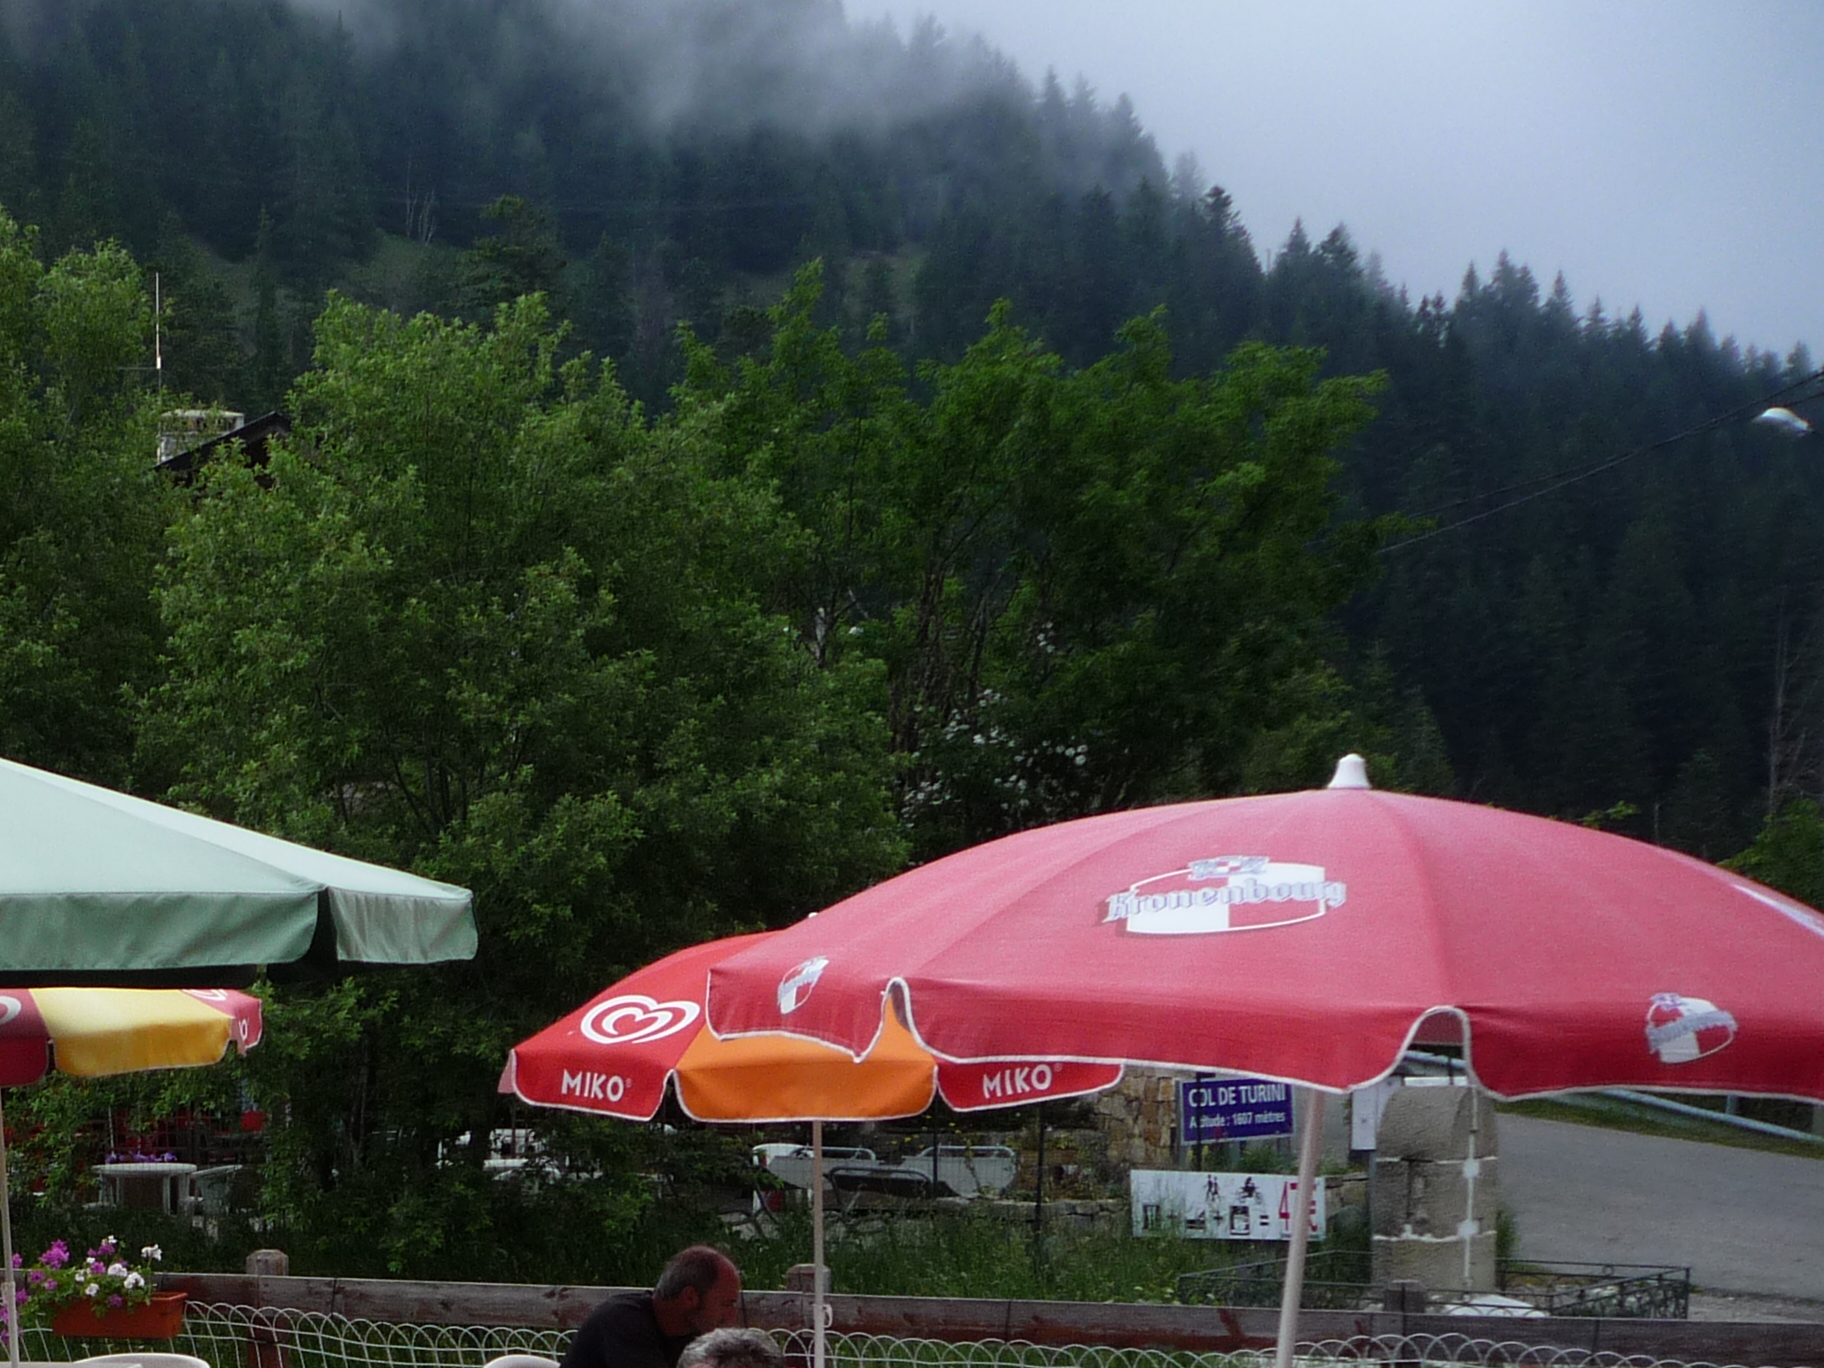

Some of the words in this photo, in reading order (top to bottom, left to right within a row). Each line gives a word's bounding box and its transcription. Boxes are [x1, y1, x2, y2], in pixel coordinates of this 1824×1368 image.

[1101, 877, 1347, 924] Kronenbourg
[560, 1067, 625, 1103] MIKO
[982, 1063, 1053, 1100] MIKO
[1217, 1086, 1237, 1106] DE
[1238, 1083, 1287, 1105] TURINI
[1189, 1112, 1226, 1129] Atitude
